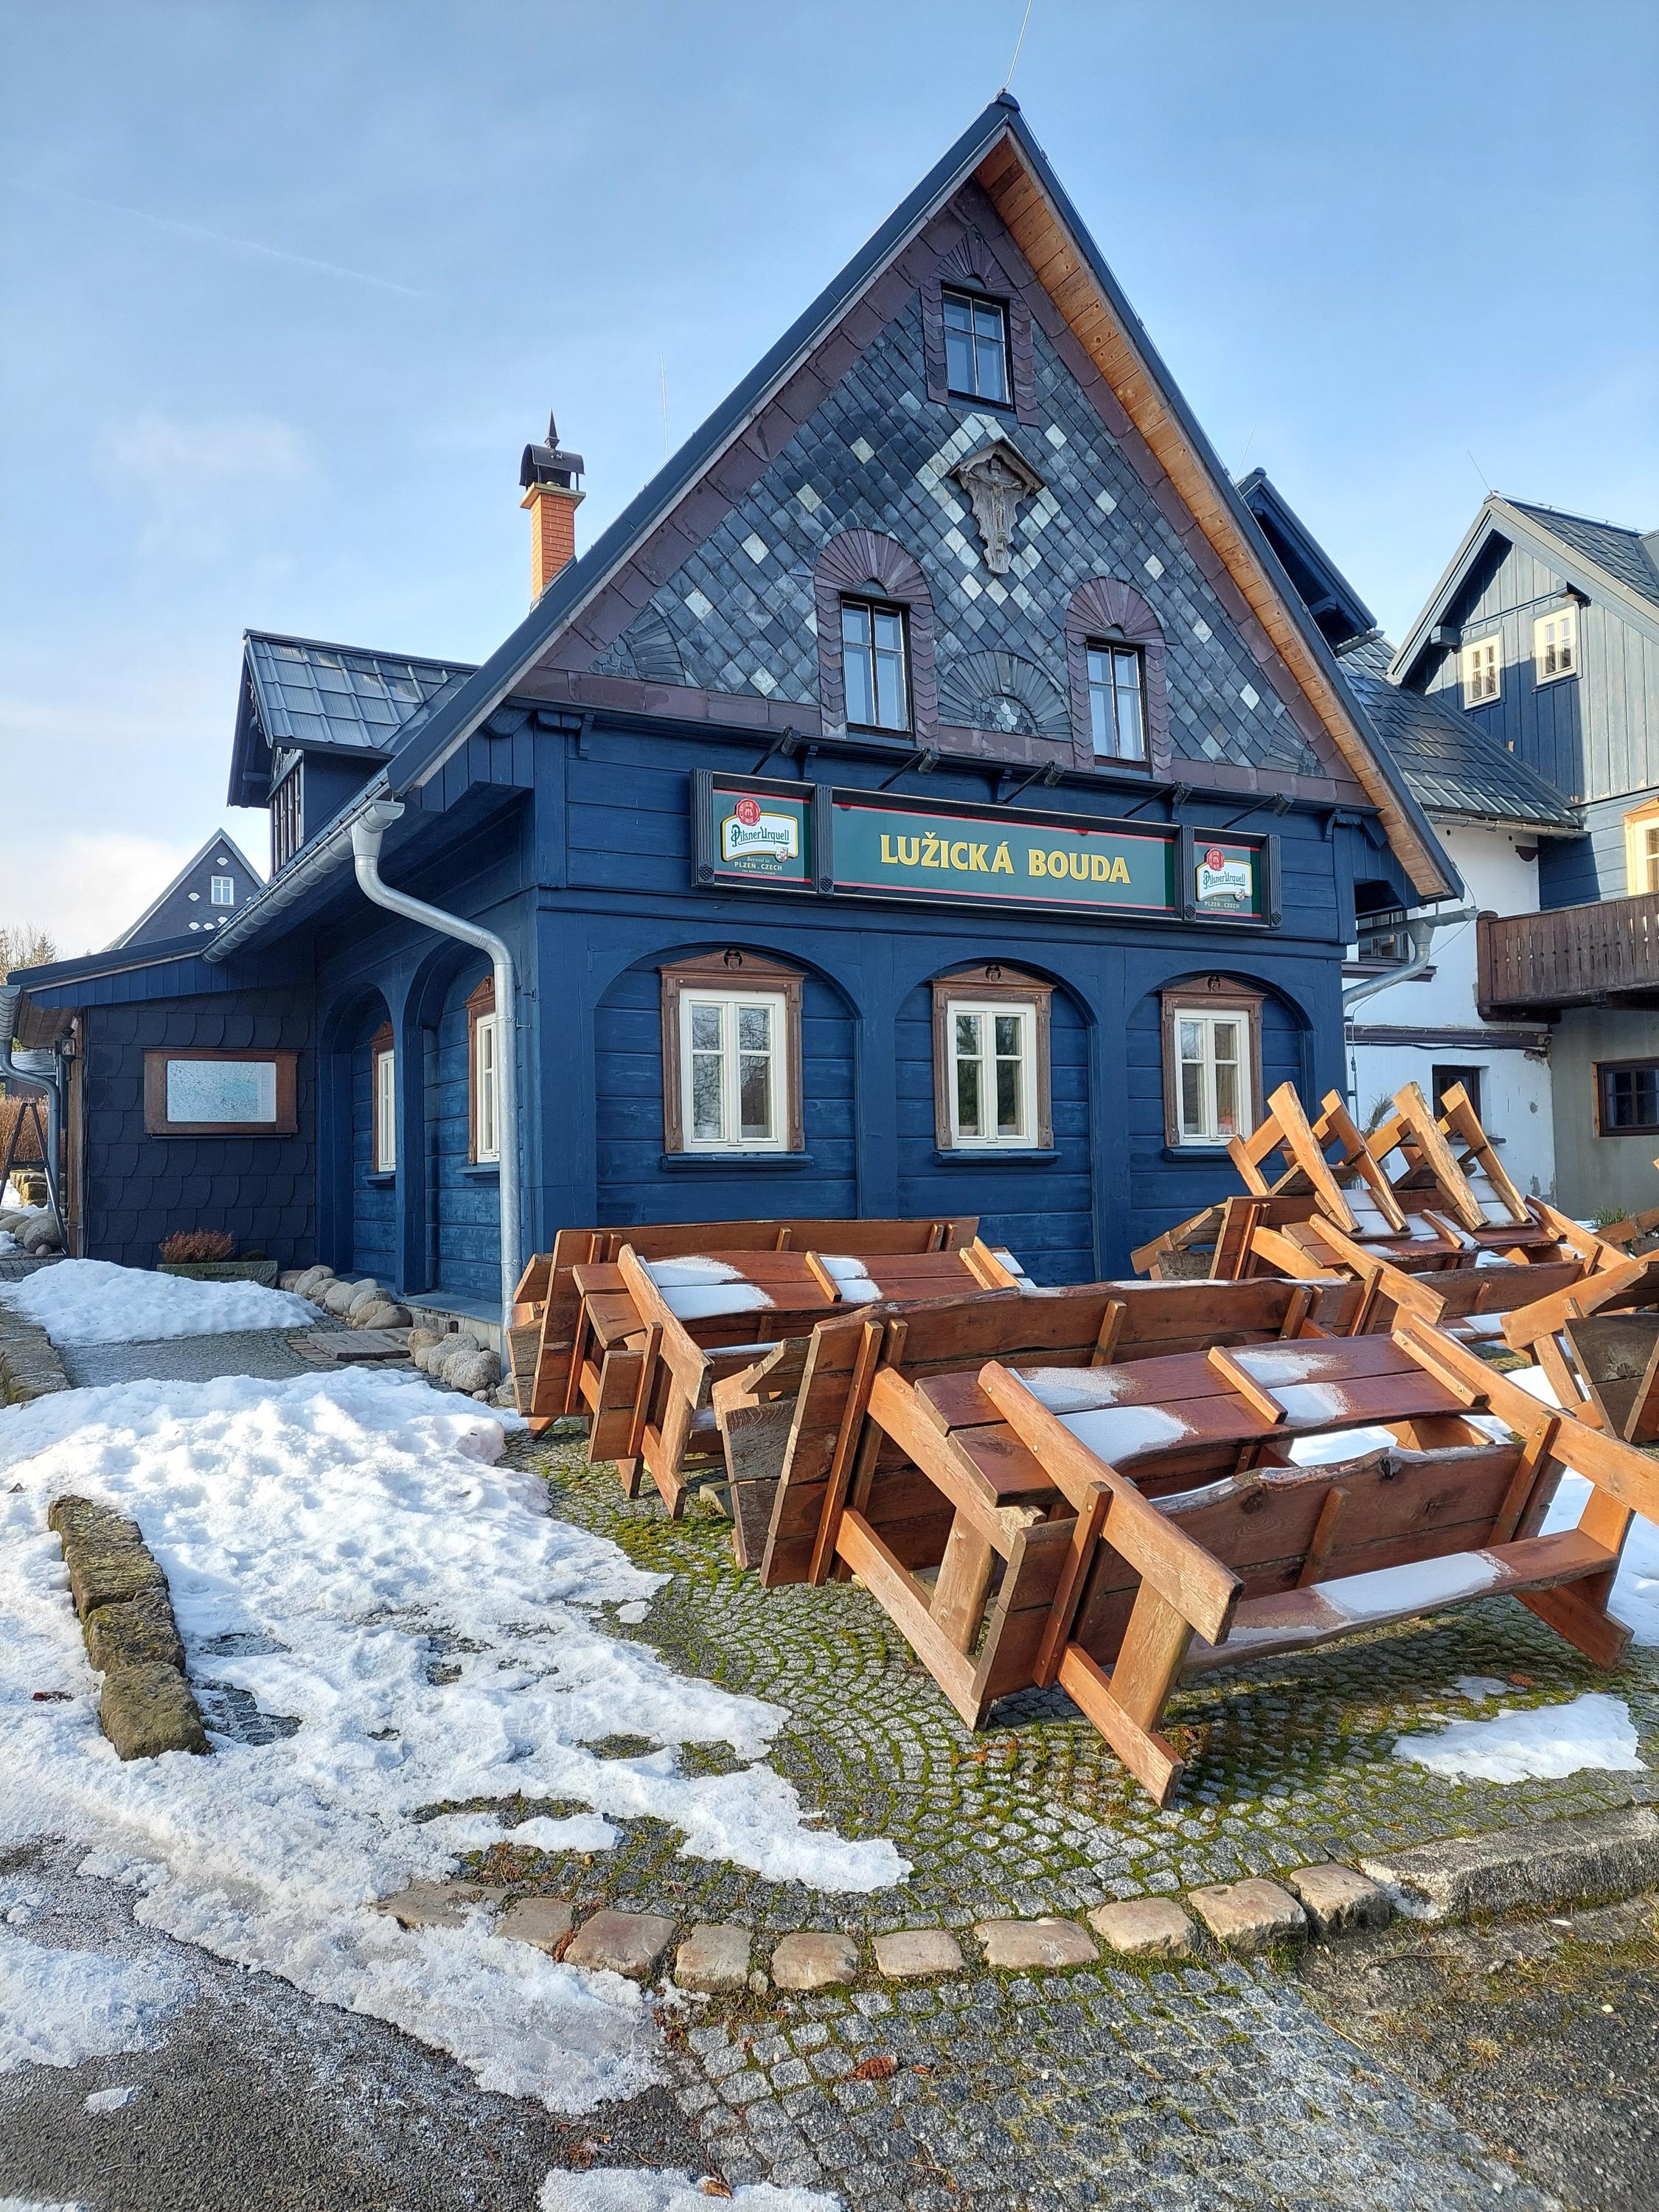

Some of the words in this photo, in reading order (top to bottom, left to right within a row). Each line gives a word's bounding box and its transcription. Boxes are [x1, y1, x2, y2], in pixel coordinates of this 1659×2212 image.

[731, 824, 761, 847] Pilsner
[760, 826, 790, 844] Urquell
[880, 831, 1015, 874] LUŽICKÁ
[1028, 849, 1132, 884] BOUDA
[1203, 870, 1225, 889] Pilsner
[1224, 871, 1246, 886] Urquell
